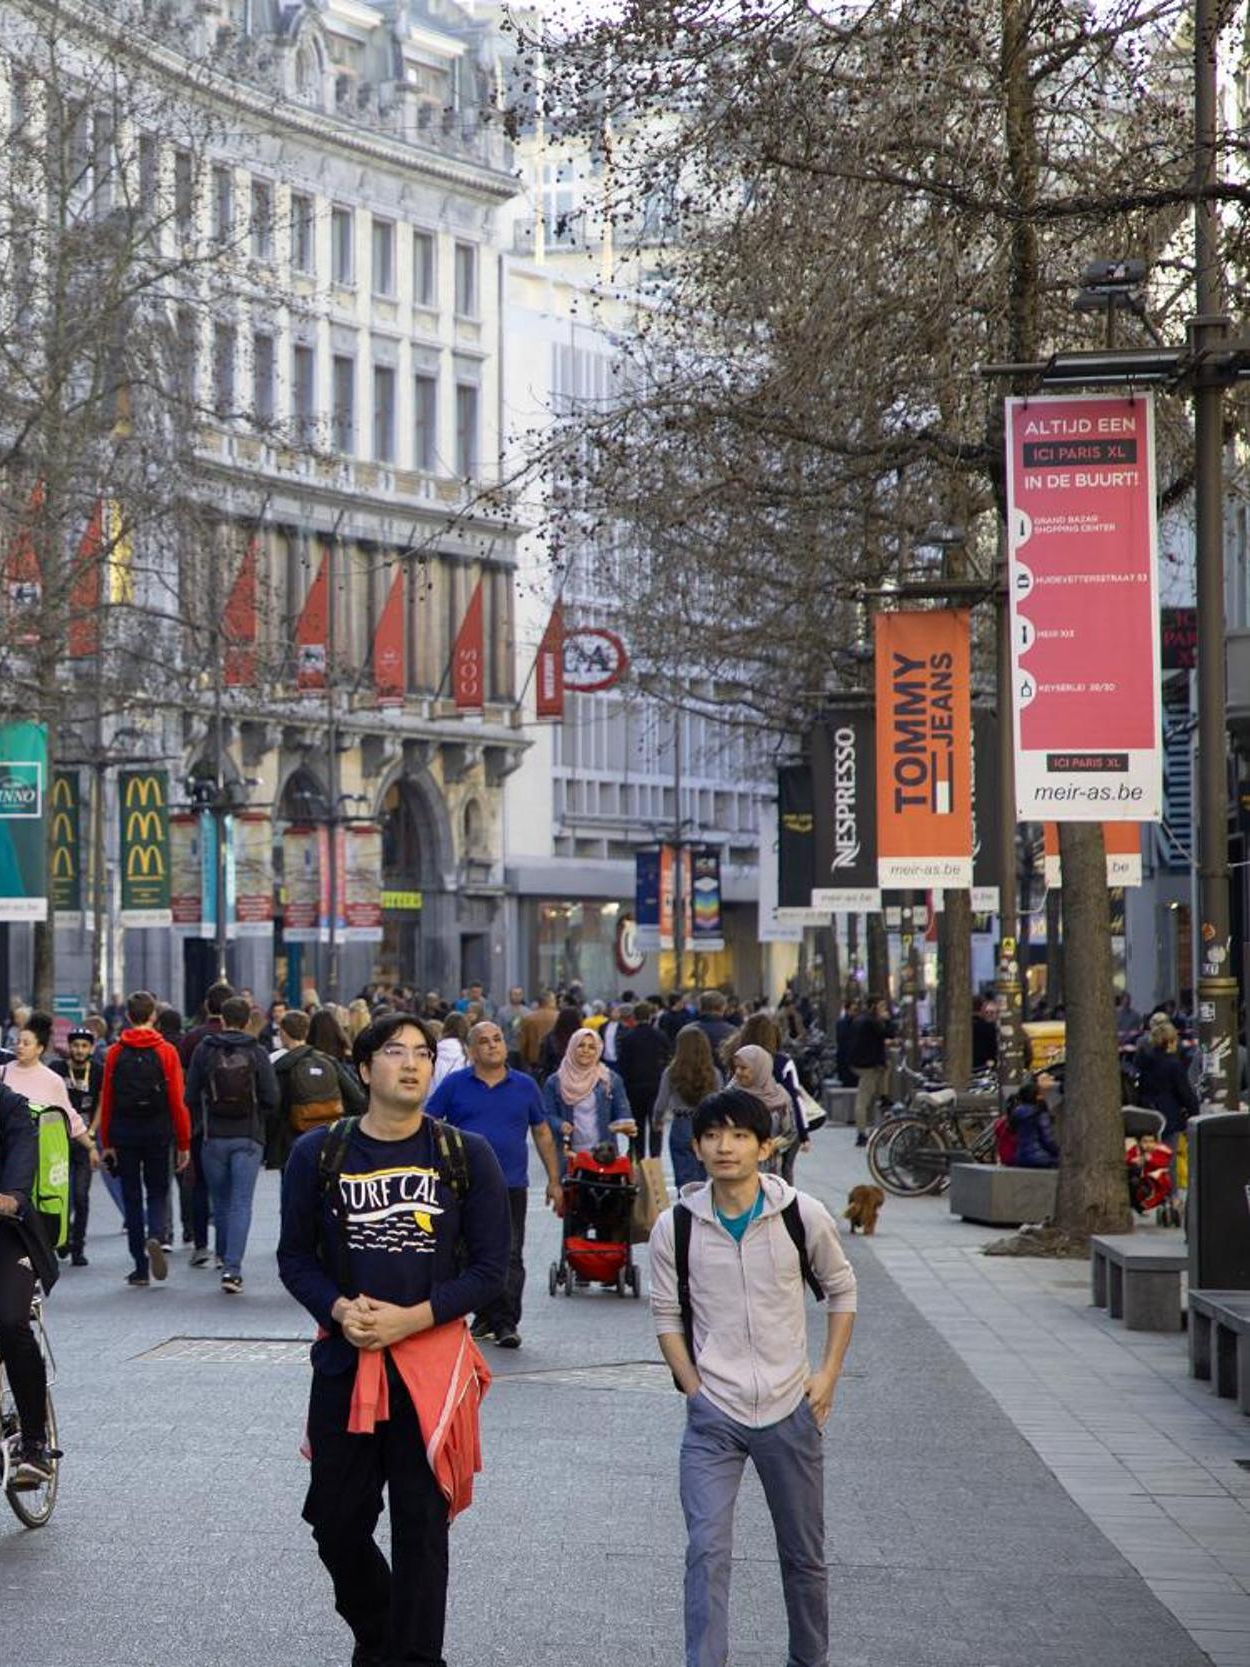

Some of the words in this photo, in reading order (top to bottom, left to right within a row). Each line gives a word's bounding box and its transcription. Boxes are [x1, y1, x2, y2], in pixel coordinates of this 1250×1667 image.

[1025, 419, 1092, 435] ALTIJD
[1098, 417, 1136, 432] EEN
[1033, 448, 1055, 461] ICI
[1059, 446, 1101, 460] PARIS
[1107, 444, 1127, 458] XL
[1024, 475, 1043, 489] IN
[1047, 474, 1071, 488] DE
[1075, 471, 1139, 487] BUURT!
[930, 652, 953, 748] JEANS
[893, 652, 927, 814] TOMMY
[1054, 759, 1069, 768] ICI
[1072, 757, 1103, 768] PARIS
[1107, 758, 1120, 767] XL
[831, 726, 861, 874] NESPRESSO
[1034, 782, 1143, 801] meir-as.be
[890, 863, 961, 876] meir-as.be
